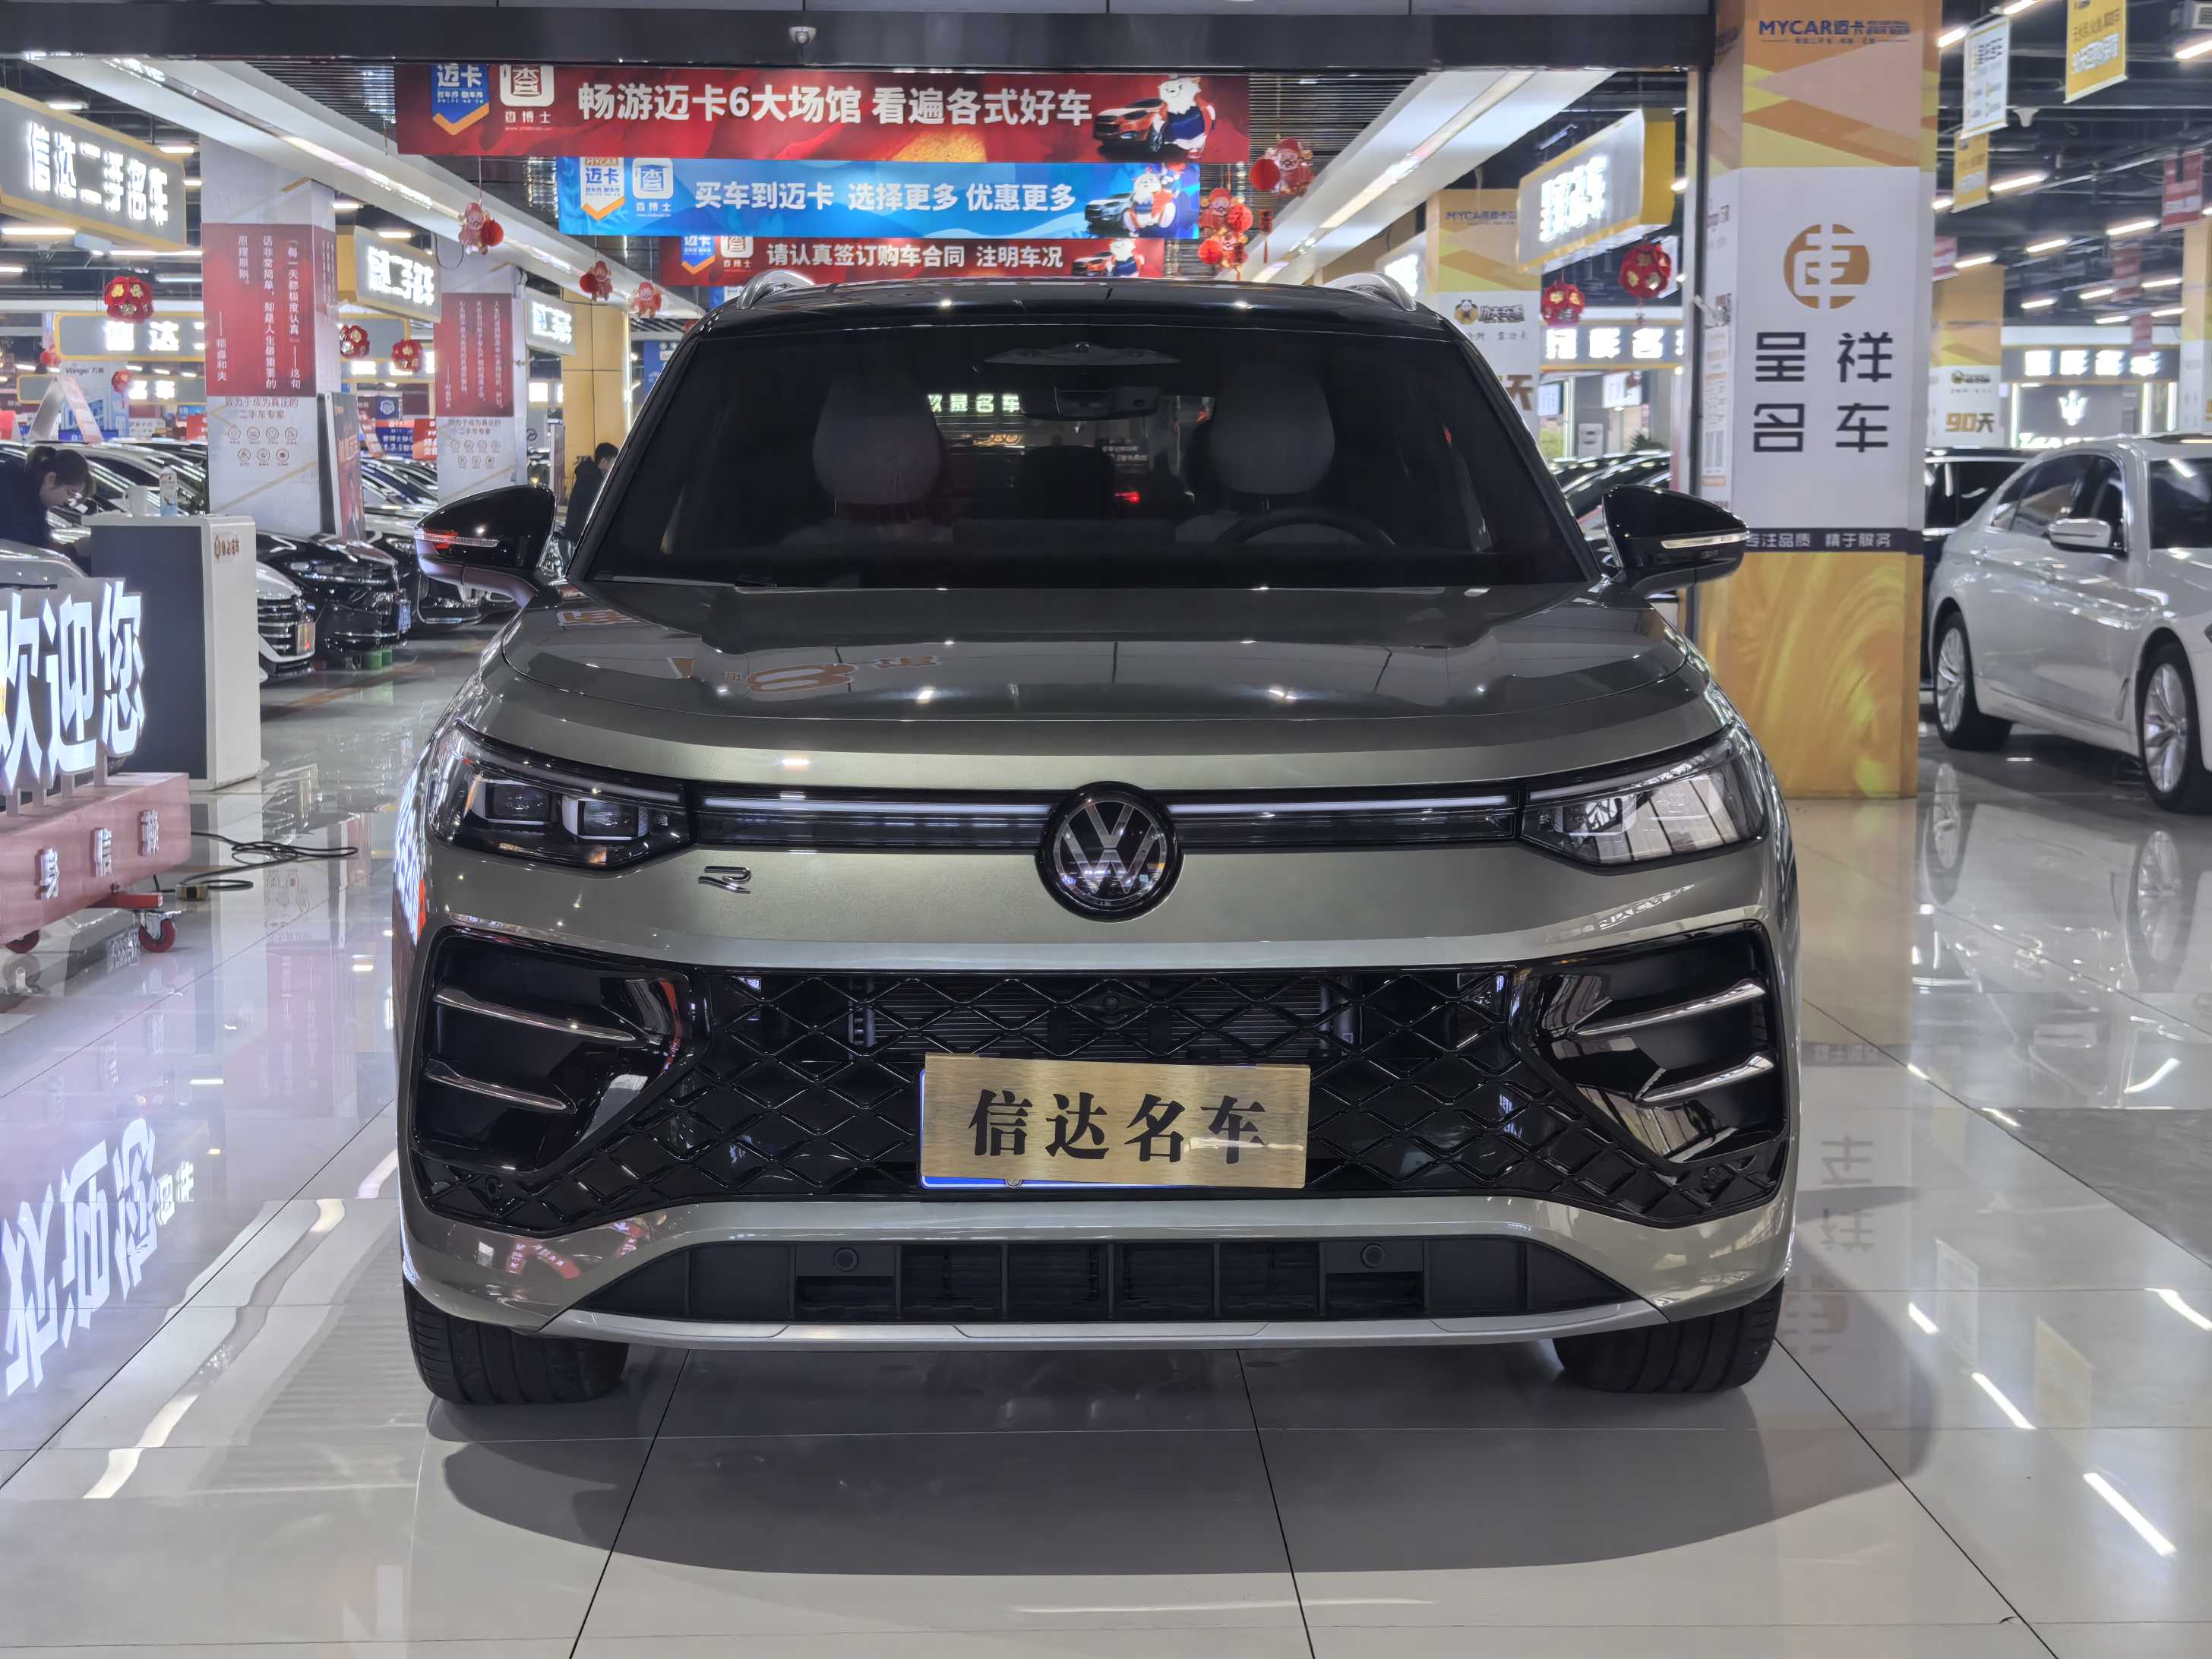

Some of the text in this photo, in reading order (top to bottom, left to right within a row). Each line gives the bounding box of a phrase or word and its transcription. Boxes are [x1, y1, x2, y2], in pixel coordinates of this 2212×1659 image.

[437, 63, 482, 87] 迈卡
[578, 81, 1092, 126] 畅游迈卡6大场馆 看遍各式好车
[586, 167, 619, 184] 迈卡
[695, 179, 1076, 213] 买车到迈卡 选择更多 优惠更多
[766, 242, 1063, 268] 请认真签订购车合同 注明车况
[1755, 331, 1894, 383] 呈祥
[1753, 403, 1890, 453] 名车
[1746, 532, 1891, 548] 专注品质 精于服务
[968, 1089, 1266, 1164] 信达名车
